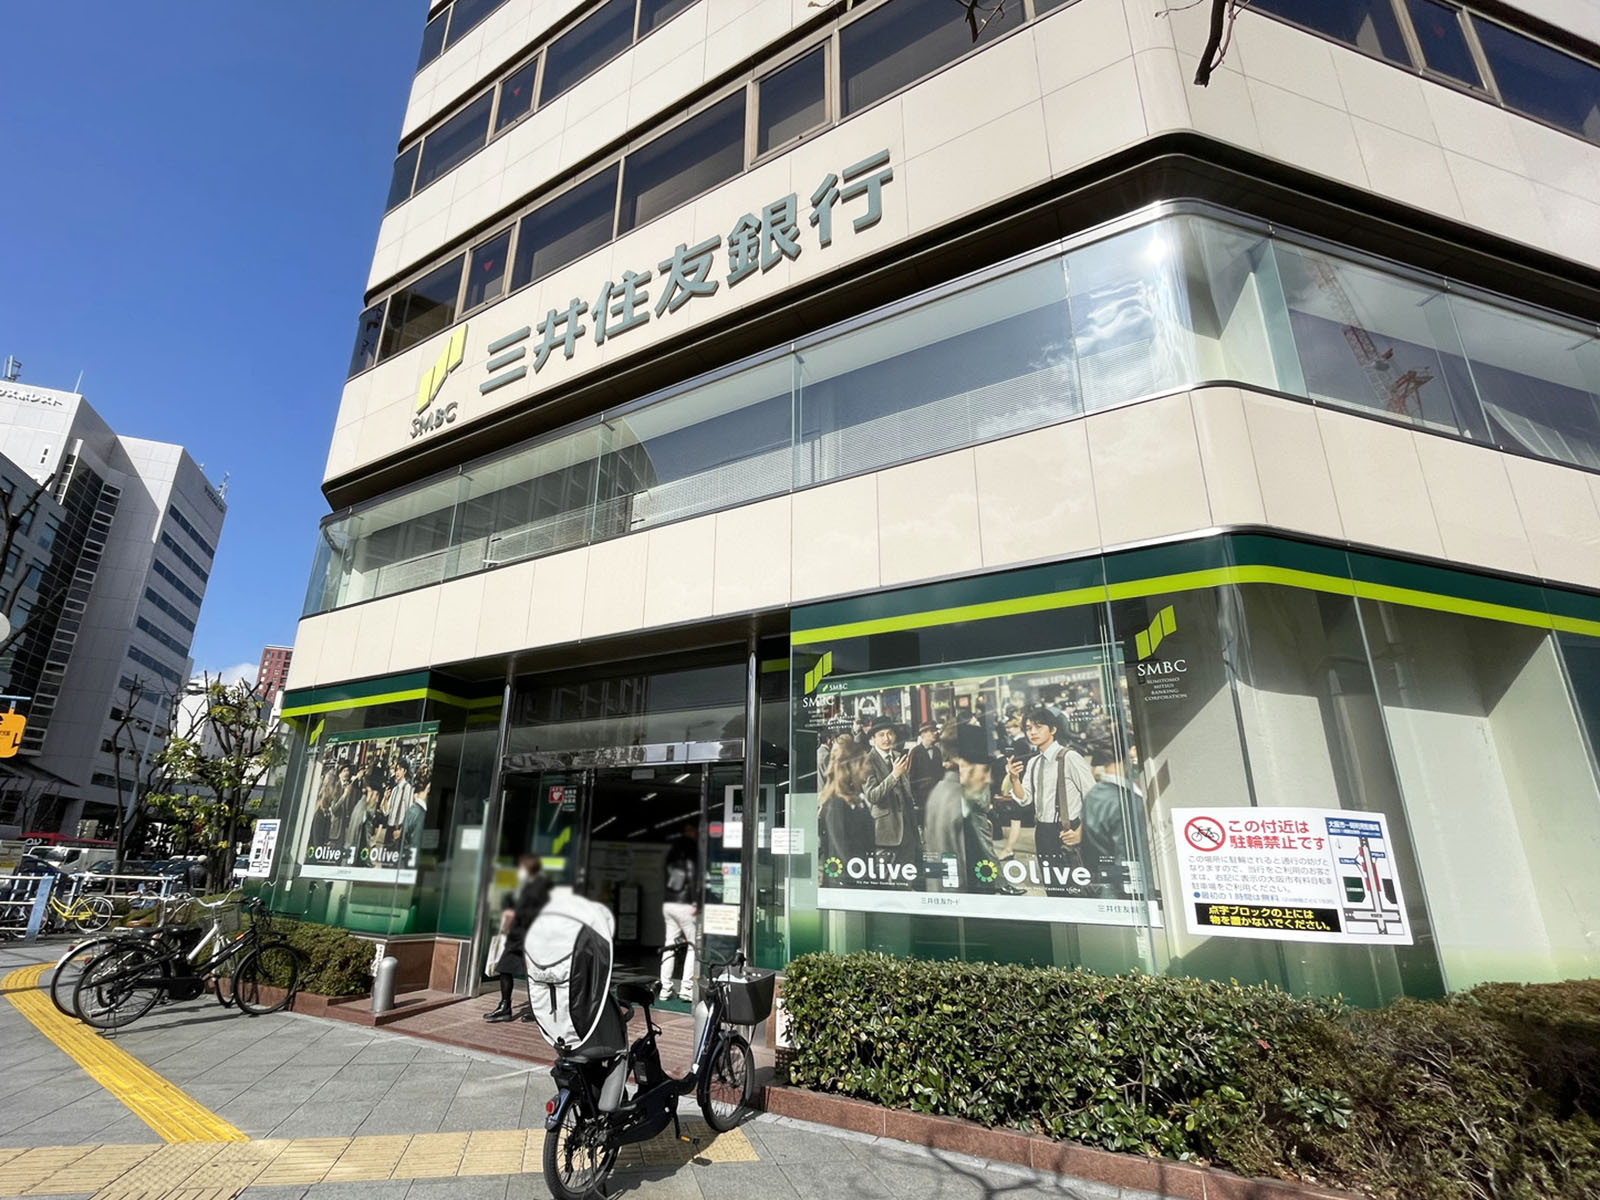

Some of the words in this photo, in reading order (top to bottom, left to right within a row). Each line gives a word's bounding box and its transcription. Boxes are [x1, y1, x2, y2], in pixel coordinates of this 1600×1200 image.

[479, 148, 894, 394] 三井住友銀行
[410, 401, 458, 439] SMBC
[1137, 659, 1187, 677] SMBC
[829, 683, 848, 691] SMBC
[803, 695, 836, 708] SMBC
[1144, 694, 1188, 702] CORPORATION
[1228, 820, 1309, 834] この付近は
[1229, 835, 1325, 850] 駐輪禁止です
[315, 845, 341, 861] Olive
[369, 847, 400, 863] Olive
[847, 857, 918, 881] Olive
[1003, 860, 1091, 886] Olive
[1208, 905, 1315, 919] 点字ブロックの上には
[1209, 915, 1331, 930] 物を置かないでください。
